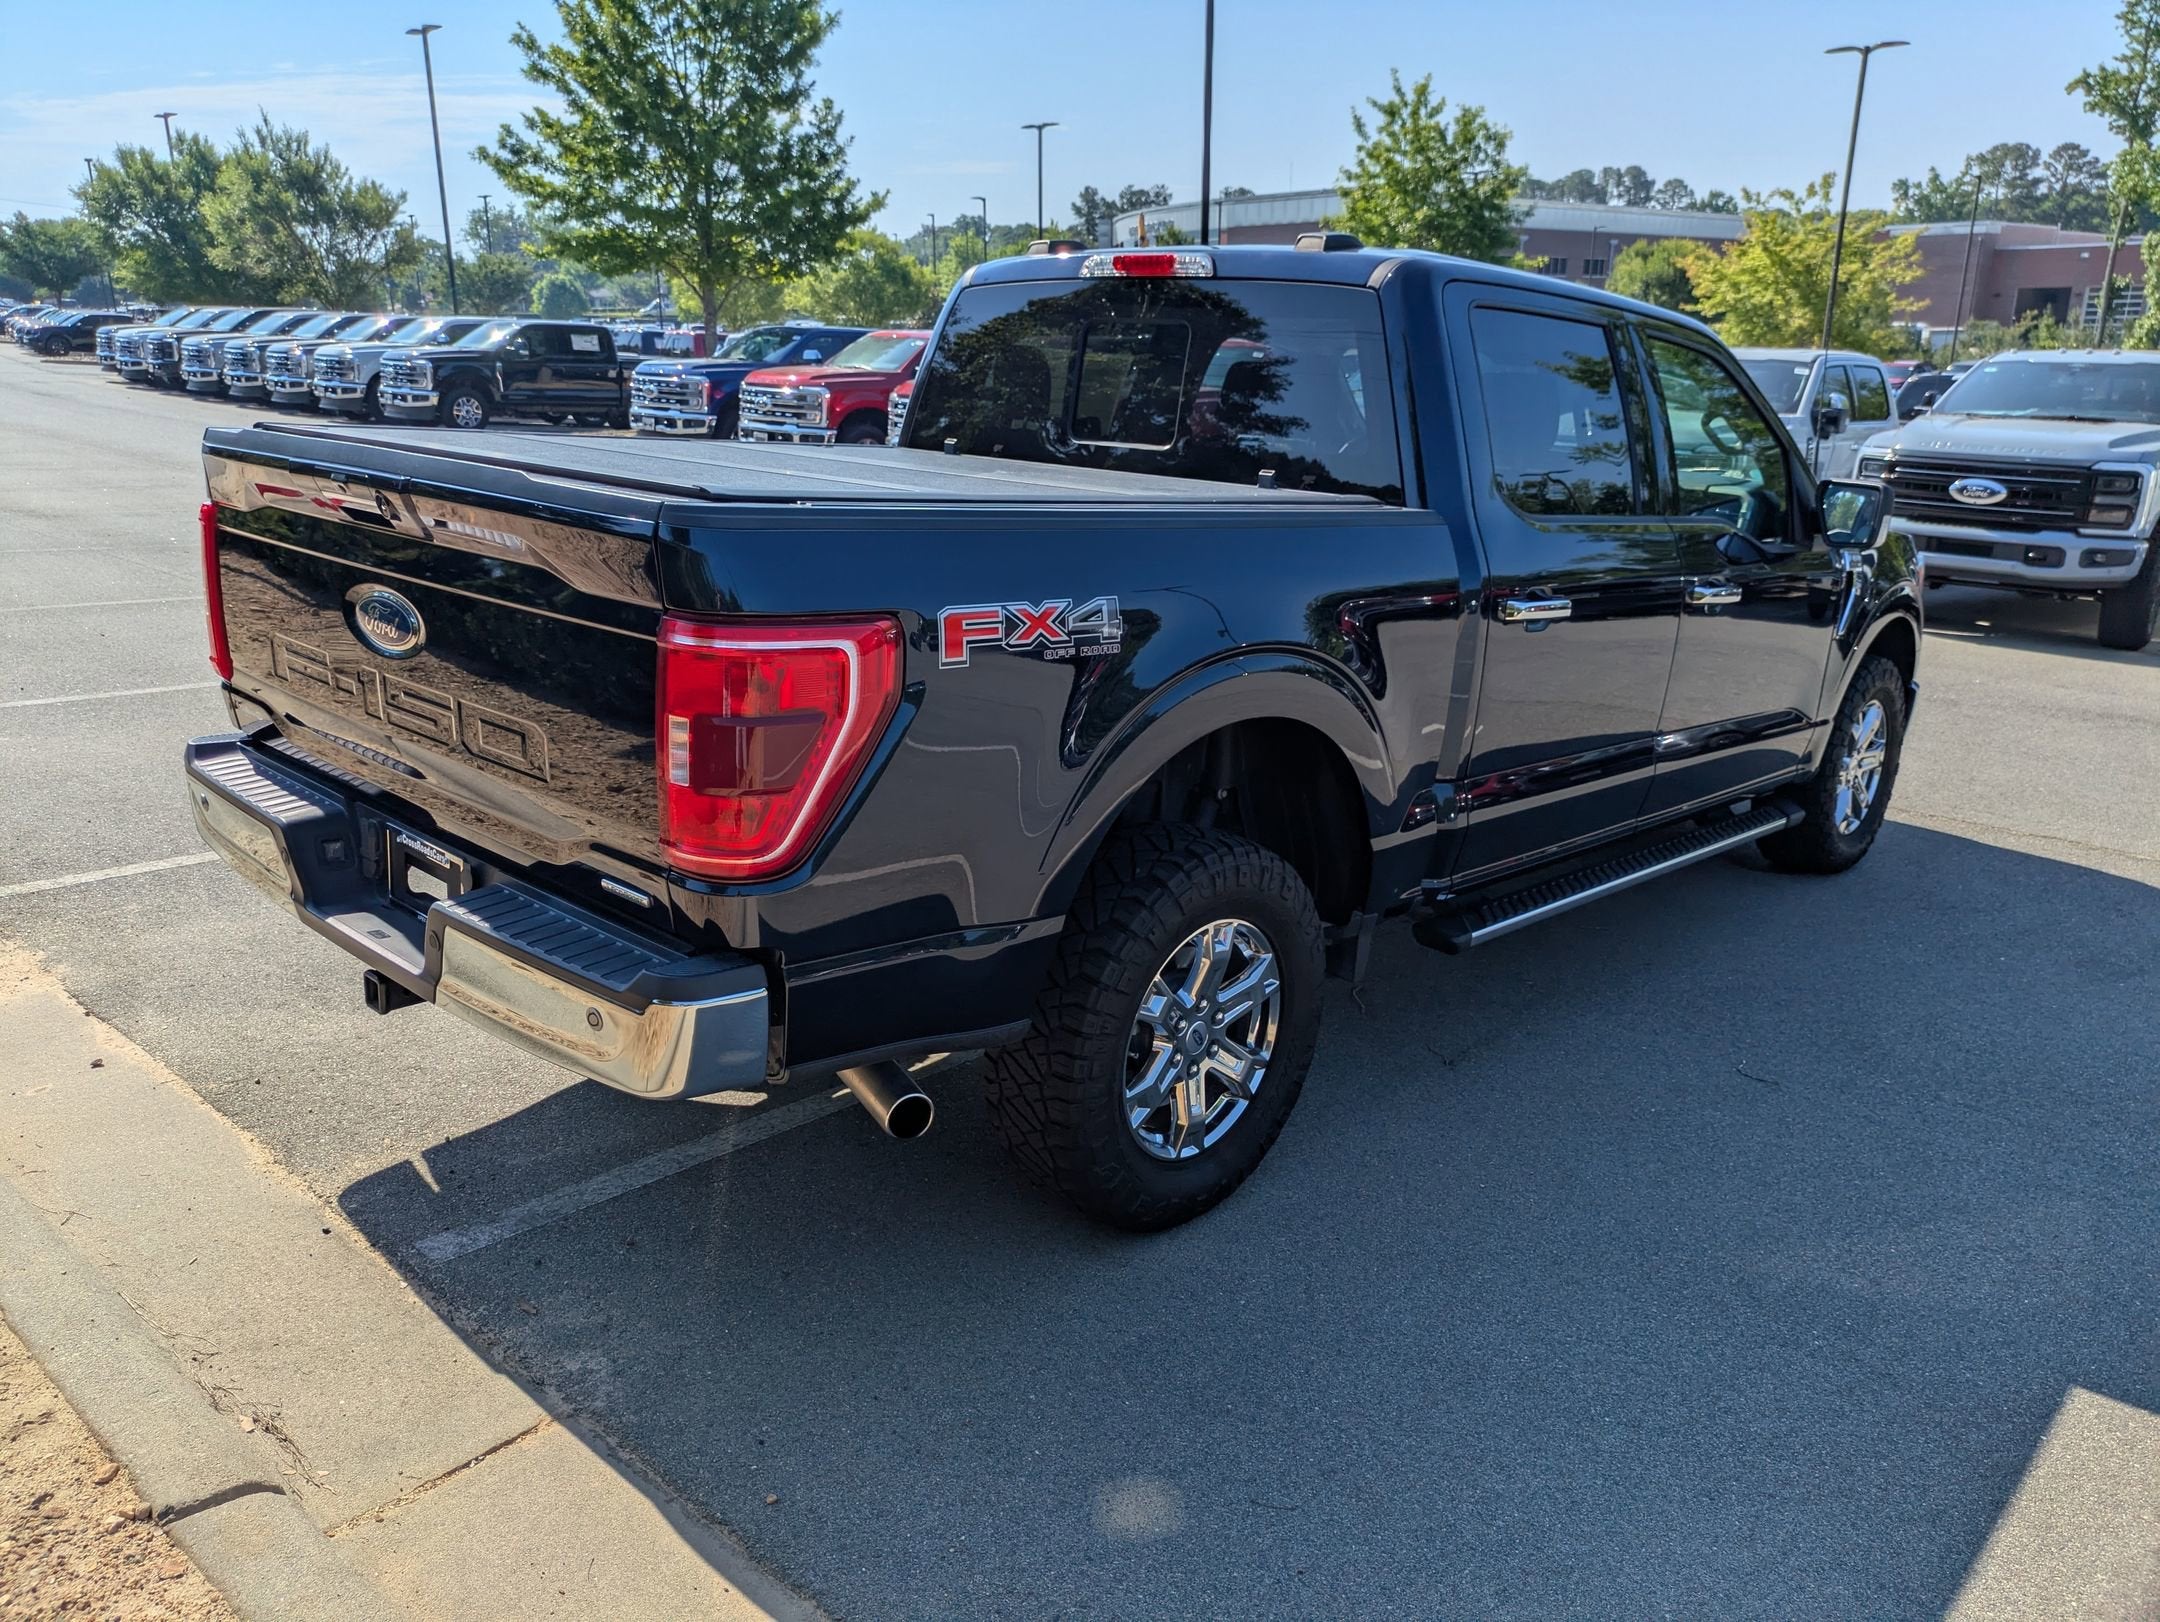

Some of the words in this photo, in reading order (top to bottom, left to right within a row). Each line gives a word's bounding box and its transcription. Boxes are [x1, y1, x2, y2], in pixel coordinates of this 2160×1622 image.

[365, 602, 400, 639] Ford
[937, 596, 1122, 669] FX4
[1043, 647, 1076, 660] OFF
[1080, 644, 1121, 656] ROAD
[271, 632, 550, 783] F-150
